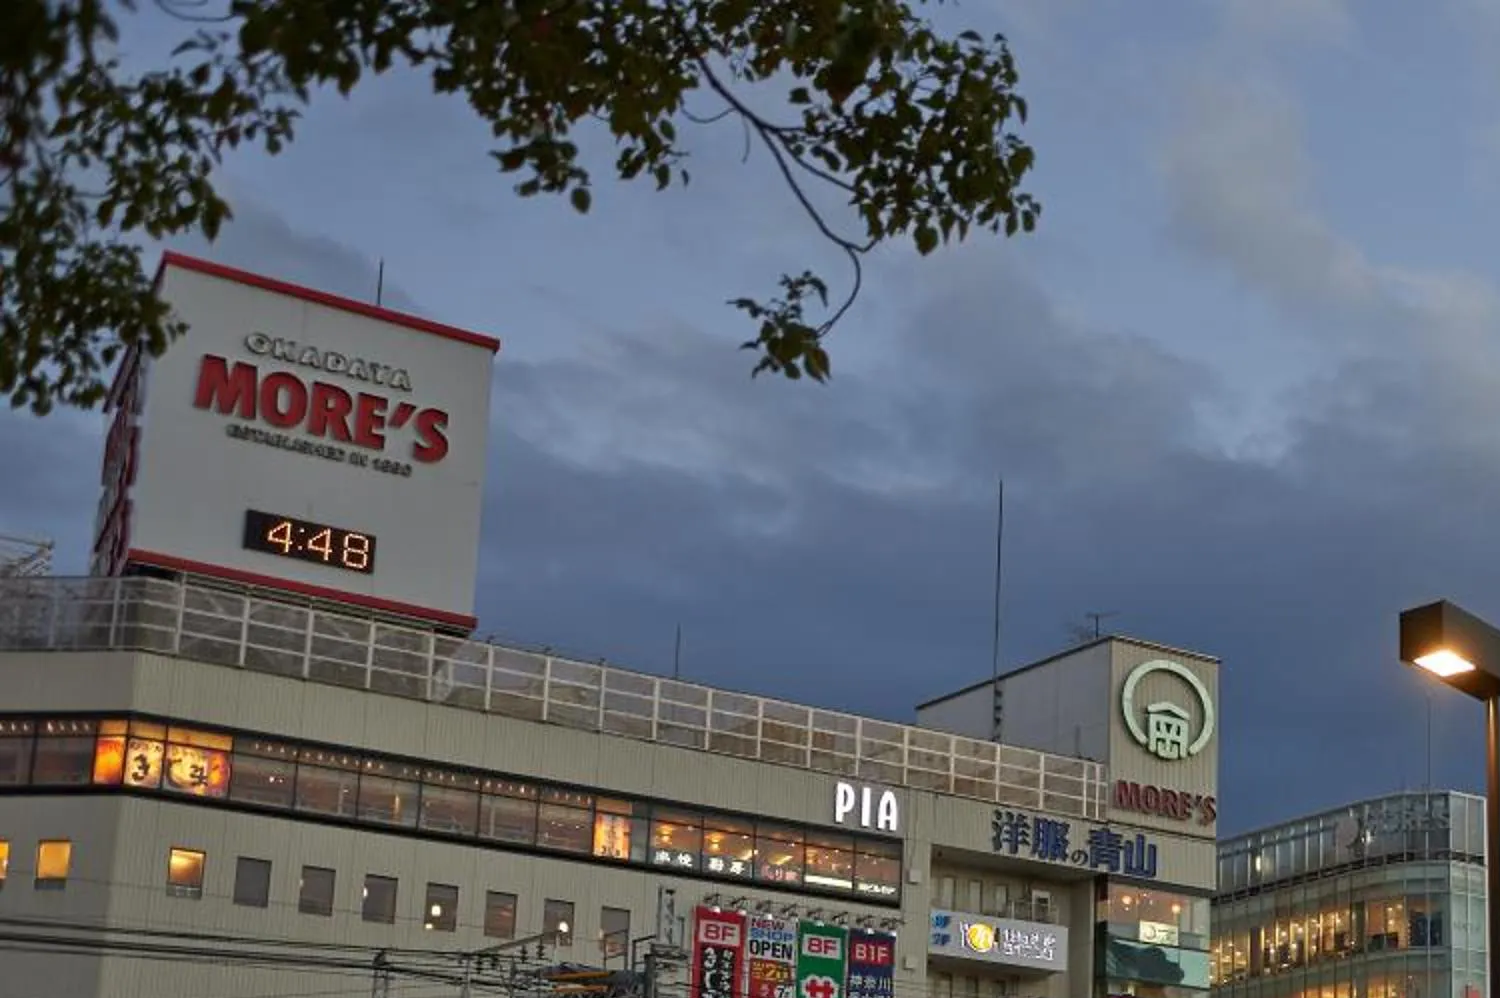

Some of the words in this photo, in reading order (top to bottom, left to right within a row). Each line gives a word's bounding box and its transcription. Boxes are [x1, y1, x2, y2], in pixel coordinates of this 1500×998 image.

[244, 332, 413, 392] OKADAYA
[193, 352, 450, 464] MORE'S
[266, 519, 371, 570] 4:48
[834, 781, 899, 832] PIA
[1115, 779, 1216, 828] MORE'S
[991, 809, 1158, 878] 洋服の青山
[703, 923, 737, 941] 8F
[749, 927, 794, 942] SHOP
[750, 917, 786, 931] NEW
[748, 939, 793, 961] OPEN
[807, 937, 837, 957] 8F
[854, 943, 890, 963] B1F
